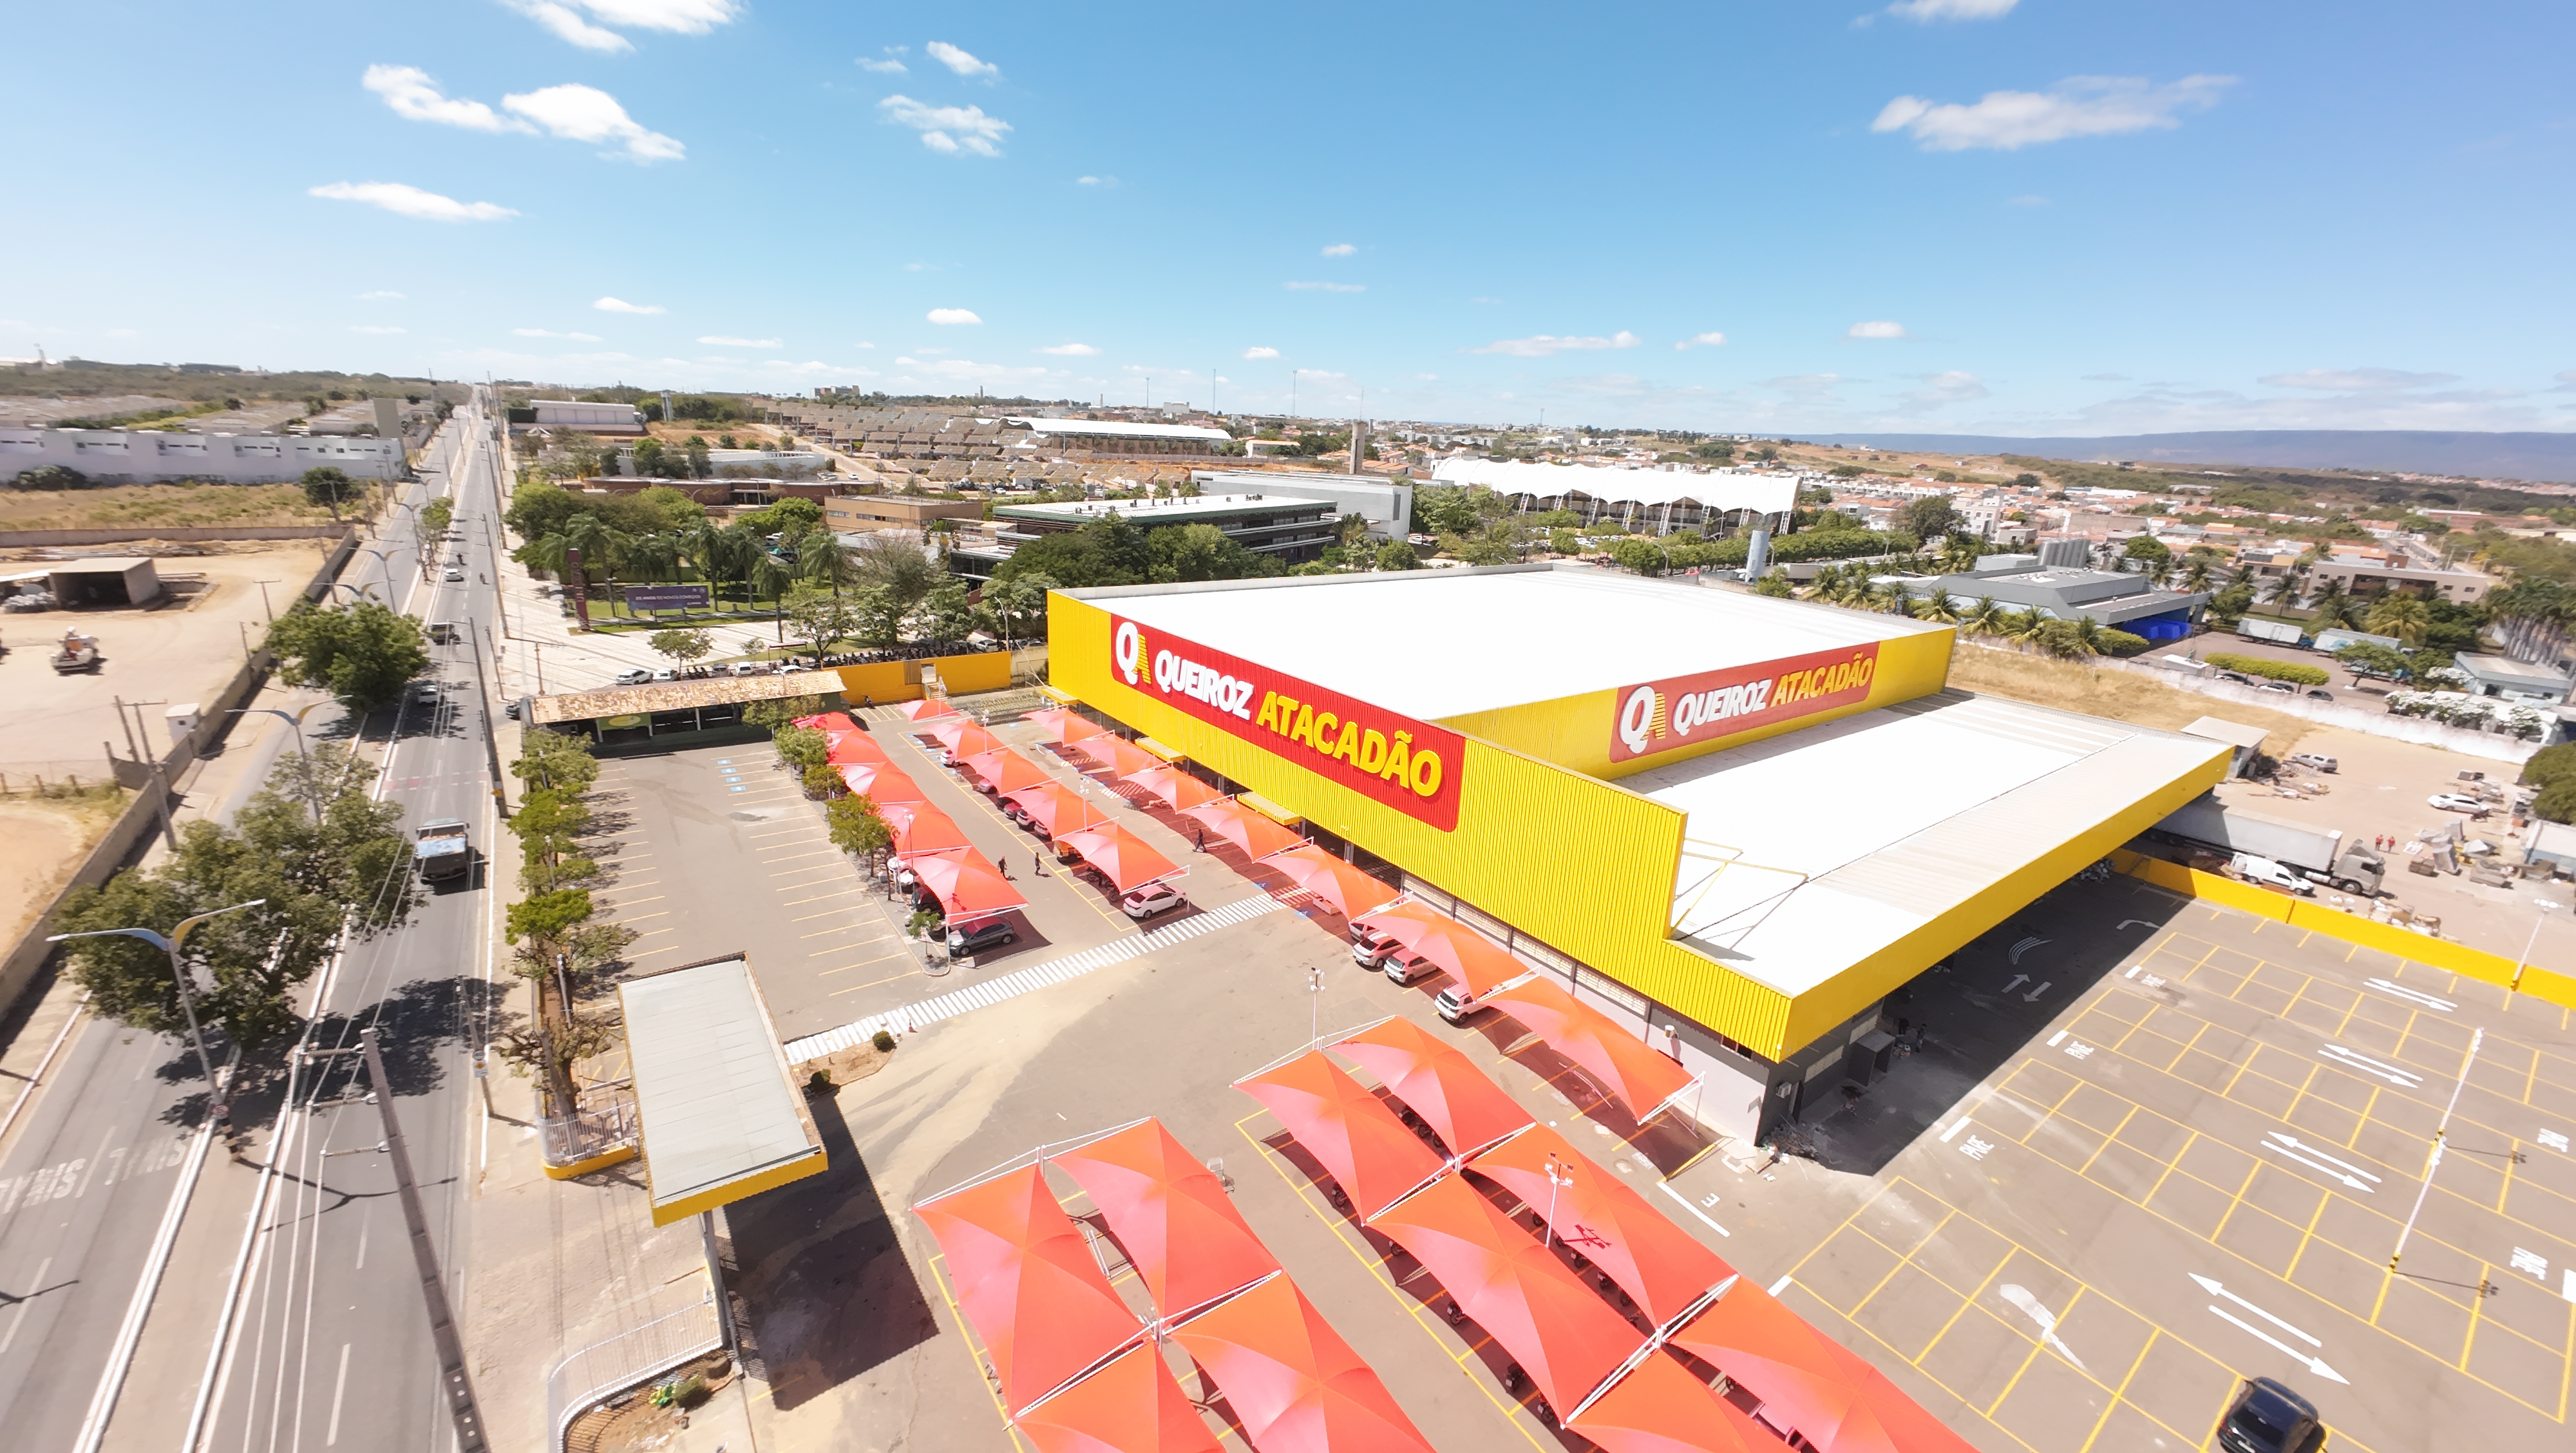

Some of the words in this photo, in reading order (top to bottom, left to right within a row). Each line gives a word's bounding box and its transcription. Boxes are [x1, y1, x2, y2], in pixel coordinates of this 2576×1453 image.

[1155, 650, 1255, 721] QUEIROZ
[1256, 691, 1442, 797] ATACADÃO
[1673, 679, 1772, 736] QUEIROZ
[1772, 652, 1873, 707] ATACADÃO
[1959, 1135, 1994, 1161] PARE
